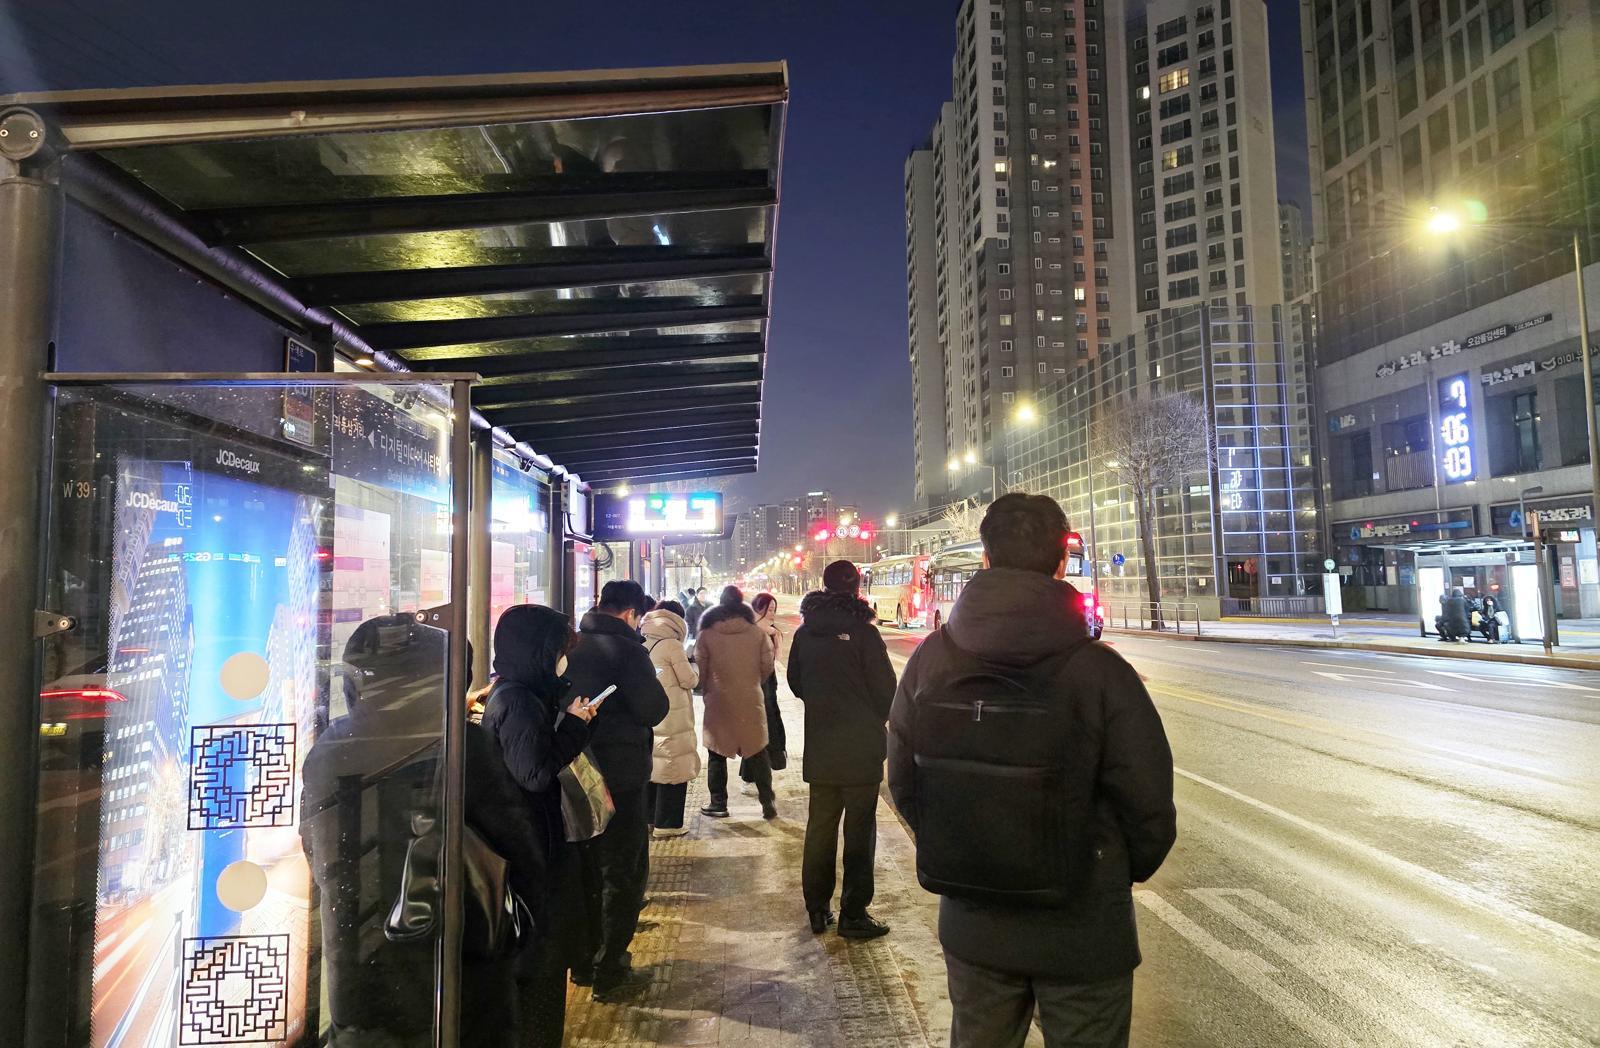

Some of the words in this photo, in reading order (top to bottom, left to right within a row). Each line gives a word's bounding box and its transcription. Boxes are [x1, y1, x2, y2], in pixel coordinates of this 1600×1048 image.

[216, 449, 261, 474] JCDecaux
[76, 481, 90, 499] 39
[126, 490, 179, 513] JCDecaux
